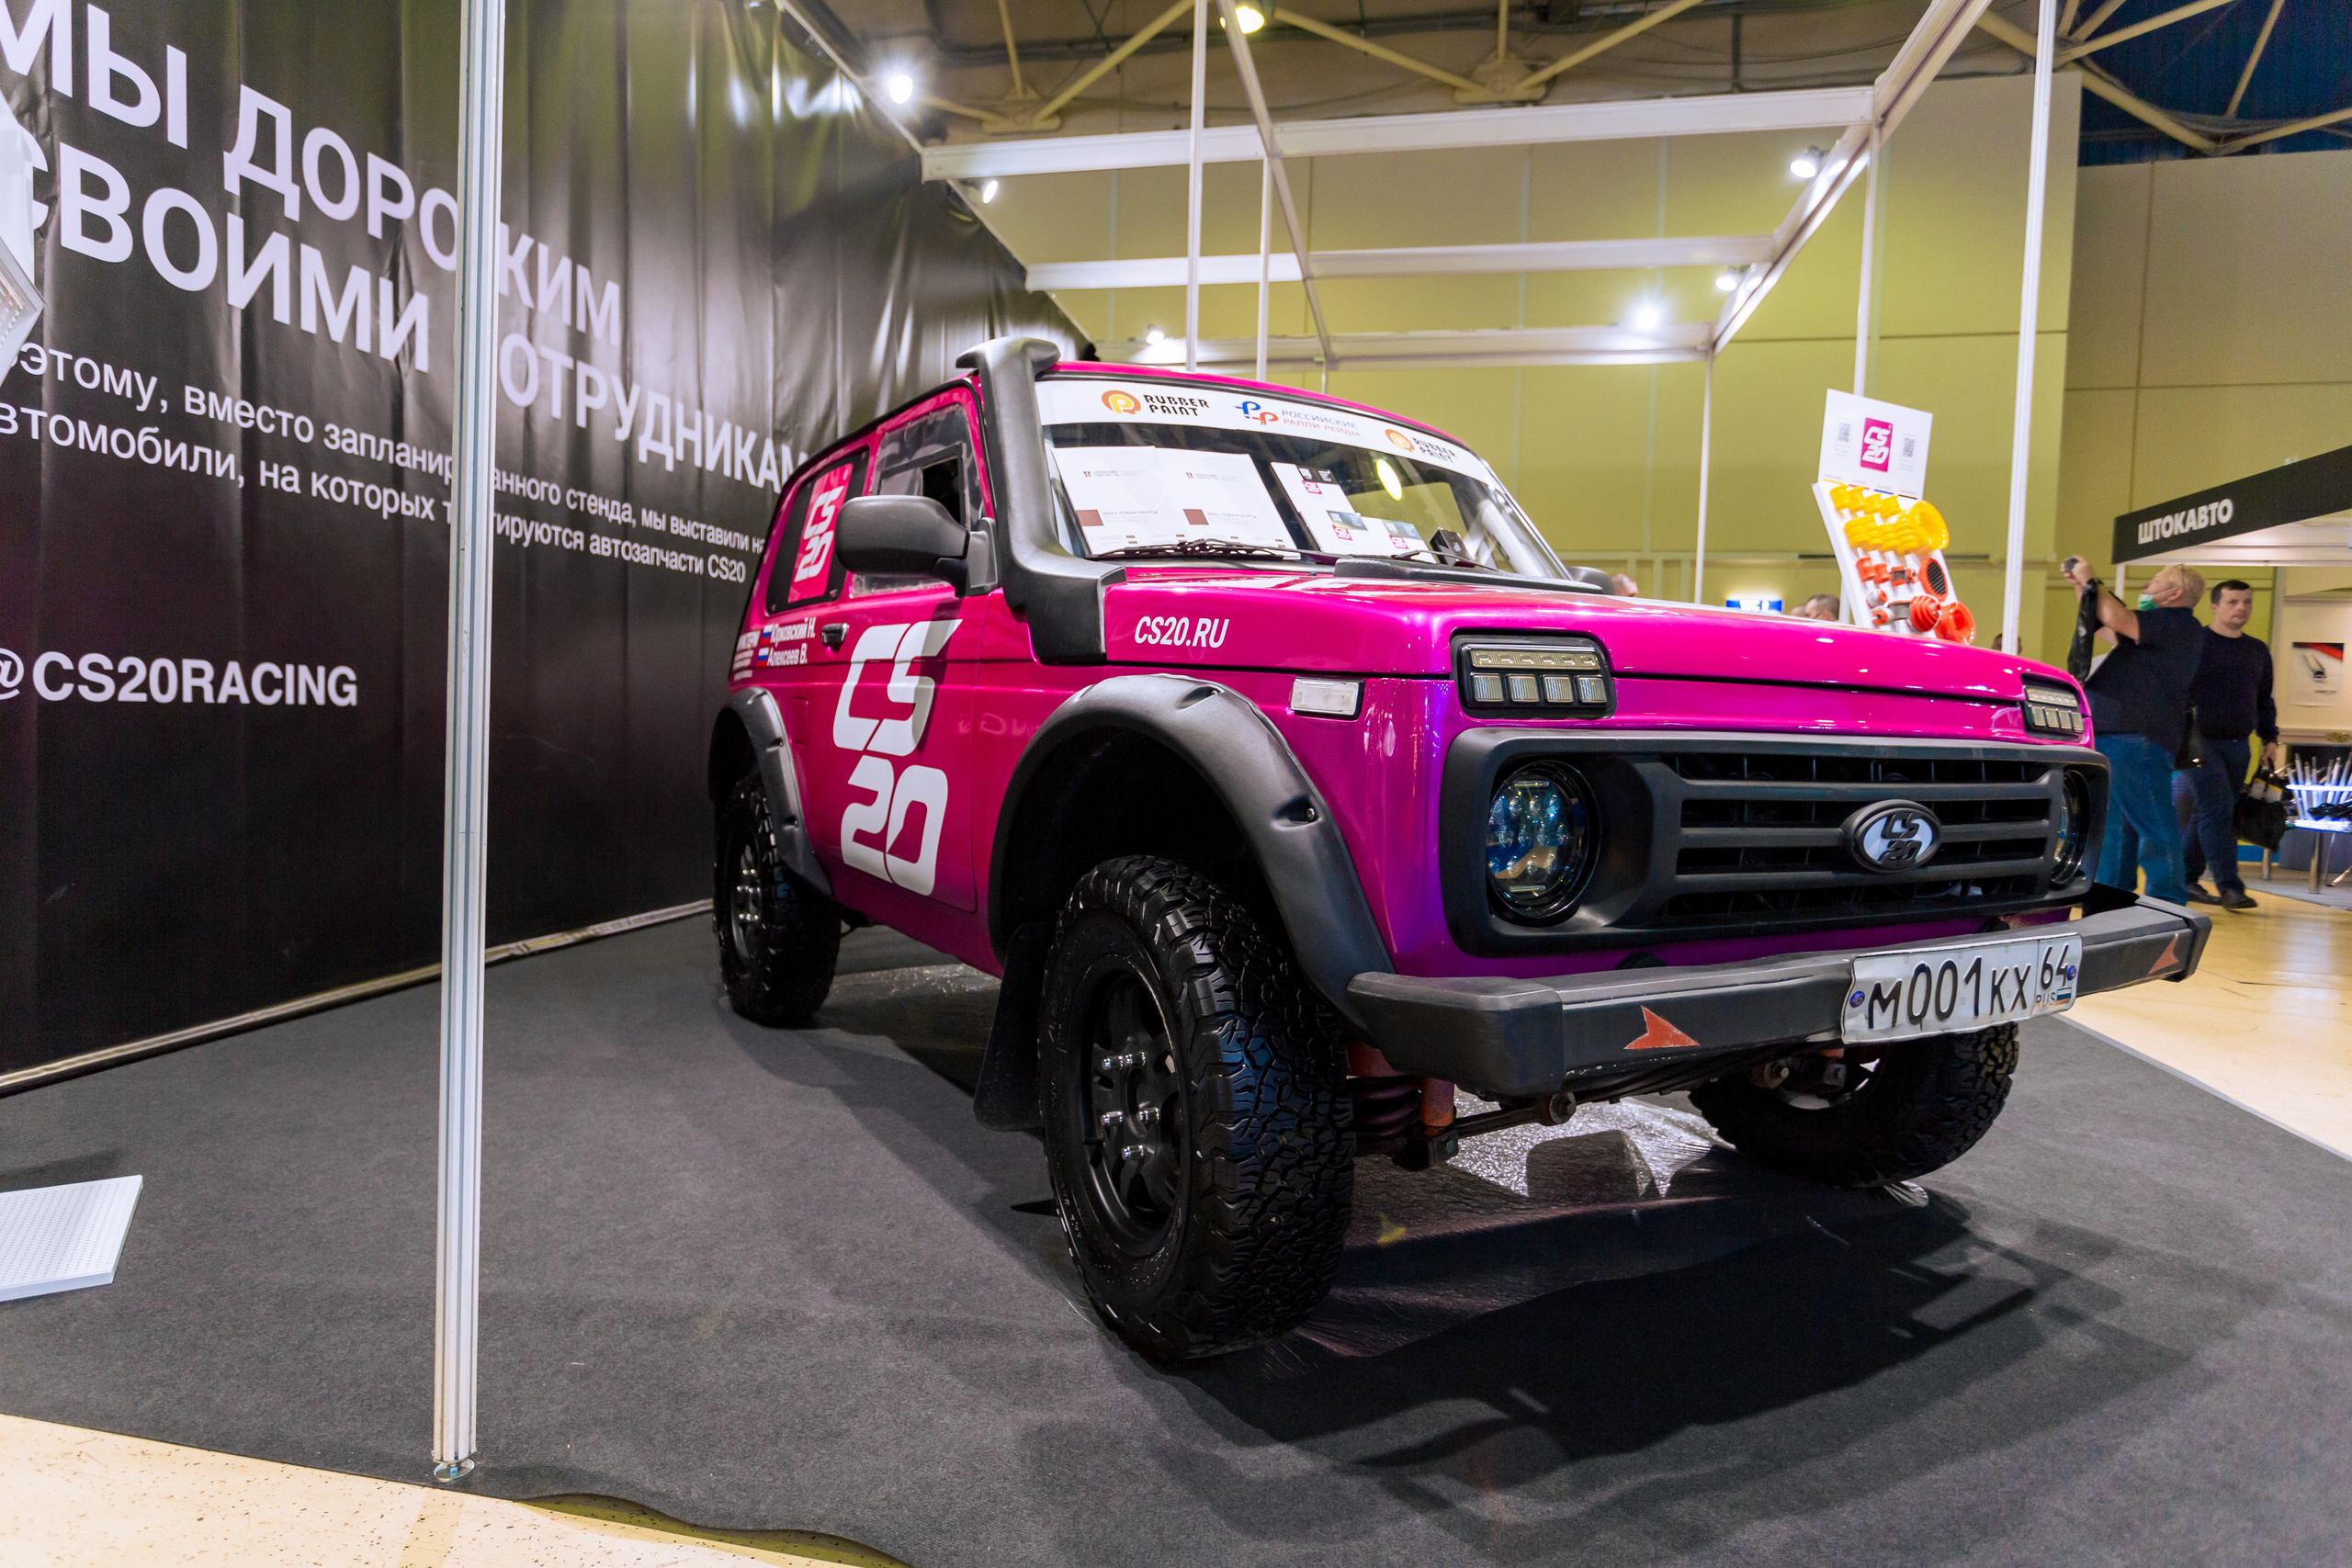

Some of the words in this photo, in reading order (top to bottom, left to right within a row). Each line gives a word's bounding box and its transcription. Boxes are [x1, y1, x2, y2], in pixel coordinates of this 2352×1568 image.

[0, 0, 187, 149] МЫ
[1143, 394, 1210, 408] RUBBER
[1149, 404, 1198, 416] PAINT
[1282, 410, 1358, 429] РОССИЙСКИЕ
[10, 343, 169, 413] этому,
[185, 385, 314, 443] вместо
[323, 423, 561, 505] запланиранного
[565, 488, 637, 527] стенда,
[641, 508, 666, 532] мы
[670, 515, 749, 551] выставили
[0, 402, 244, 489] втомобили,
[260, 460, 300, 494] на
[311, 471, 435, 521] которых
[590, 534, 704, 575] автозапчасти
[707, 554, 746, 583] CS20
[2138, 498, 2234, 545] ШТОКАВТО
[1134, 615, 1229, 649] CS20.RU
[766, 647, 800, 667] Алексеев
[2041, 943, 2070, 989] 64
[2035, 992, 2057, 1009] RUS
